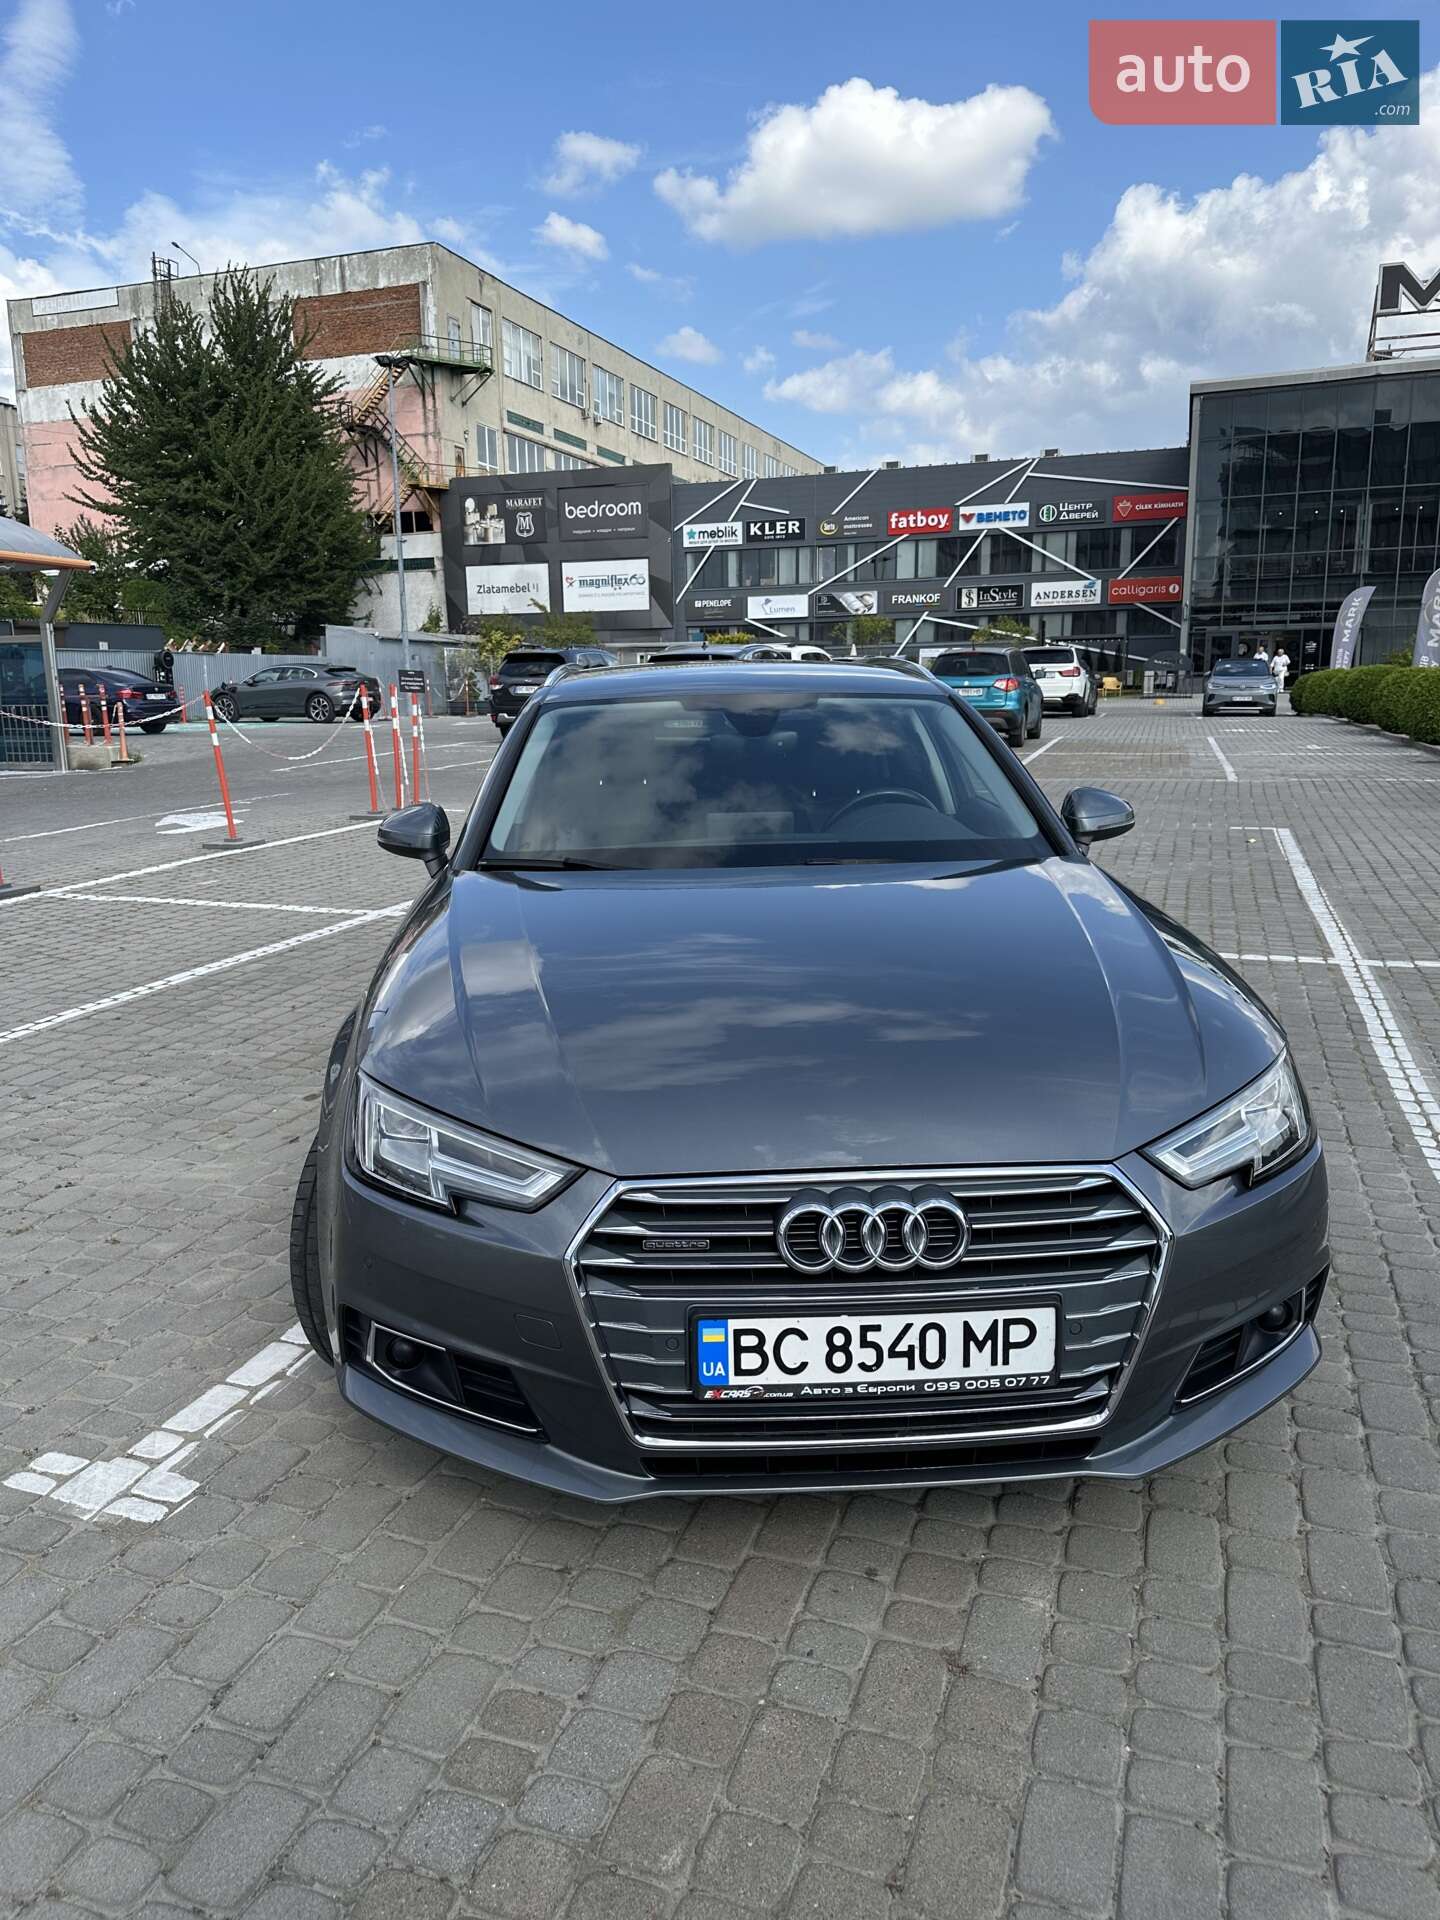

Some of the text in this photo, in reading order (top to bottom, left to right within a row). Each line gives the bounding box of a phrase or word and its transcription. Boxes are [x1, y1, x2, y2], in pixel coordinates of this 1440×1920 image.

[506, 497, 543, 507] MARAFET
[565, 501, 642, 519] bedroom
[698, 526, 738, 540] meblik
[750, 520, 800, 536] KLER
[476, 582, 531, 594] Zlatamebel
[979, 587, 1018, 602] InStyle
[1111, 584, 1166, 597] calligaris
[891, 593, 941, 604] FRANKOF
[1034, 589, 1097, 601] ANDERSEN
[769, 606, 796, 614] Lumen
[646, 1241, 707, 1249] quattro
[733, 1317, 1038, 1377] BC 8540 MP
[702, 1361, 726, 1377] UA
[923, 1381, 961, 1392] 099
[964, 1378, 1001, 1389] 005
